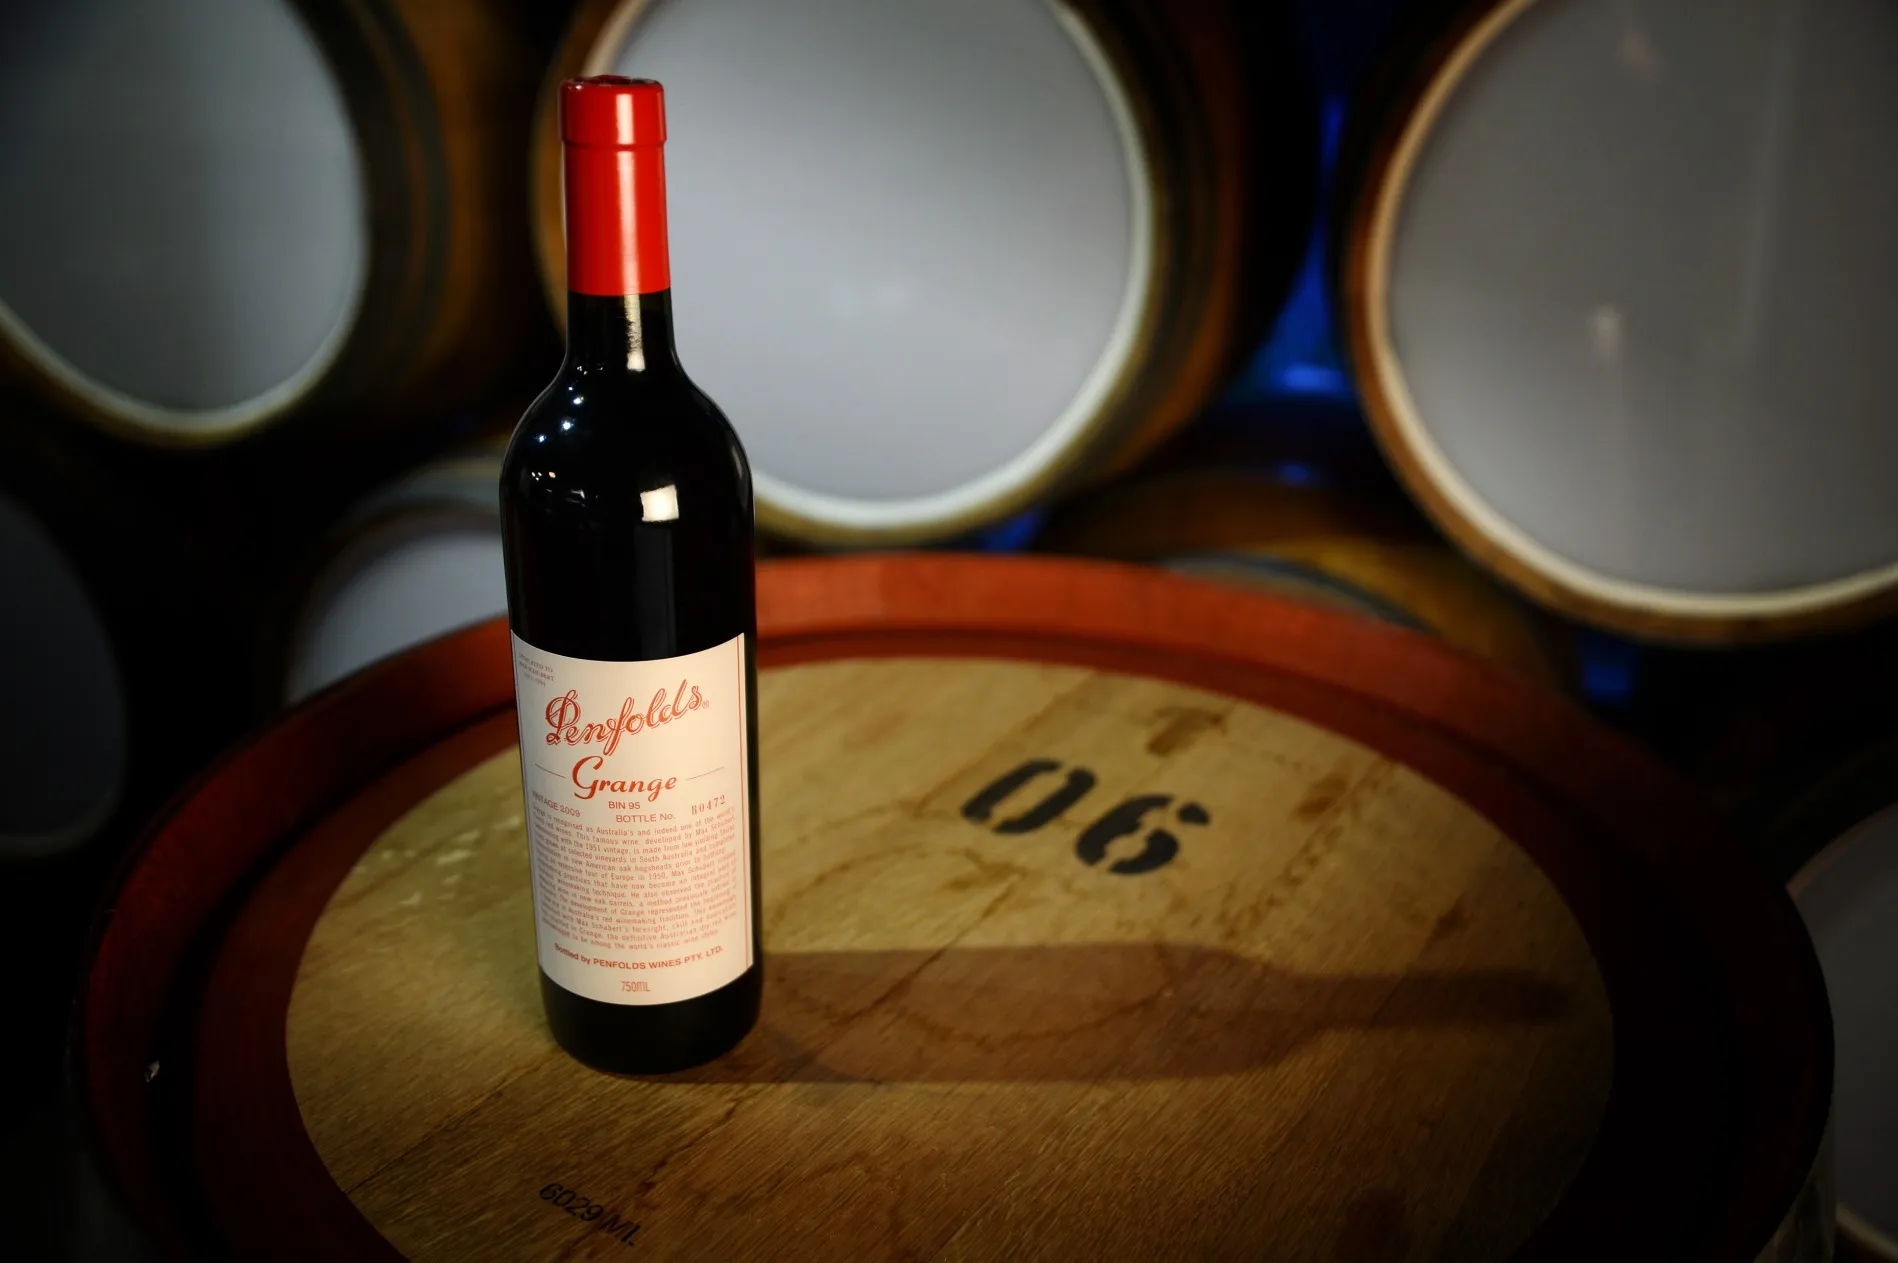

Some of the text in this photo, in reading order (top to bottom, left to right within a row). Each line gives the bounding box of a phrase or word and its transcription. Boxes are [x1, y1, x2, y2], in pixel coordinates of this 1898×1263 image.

[545, 679, 703, 756] Penfolds
[572, 755, 677, 802] Grange
[608, 800, 626, 809] BIN
[560, 805, 580, 817] 2009
[960, 758, 1212, 876] 06
[616, 814, 656, 823] BOTTLE
[597, 827, 634, 836] Australia's
[577, 832, 590, 841] This
[593, 836, 618, 844] famous
[645, 835, 681, 845] developed
[586, 843, 600, 851] 1951
[663, 850, 692, 860] Australia
[554, 942, 723, 970] Bottled by PENFOLDS WINES PTY. LTD.
[539, 1182, 604, 1222] 6029
